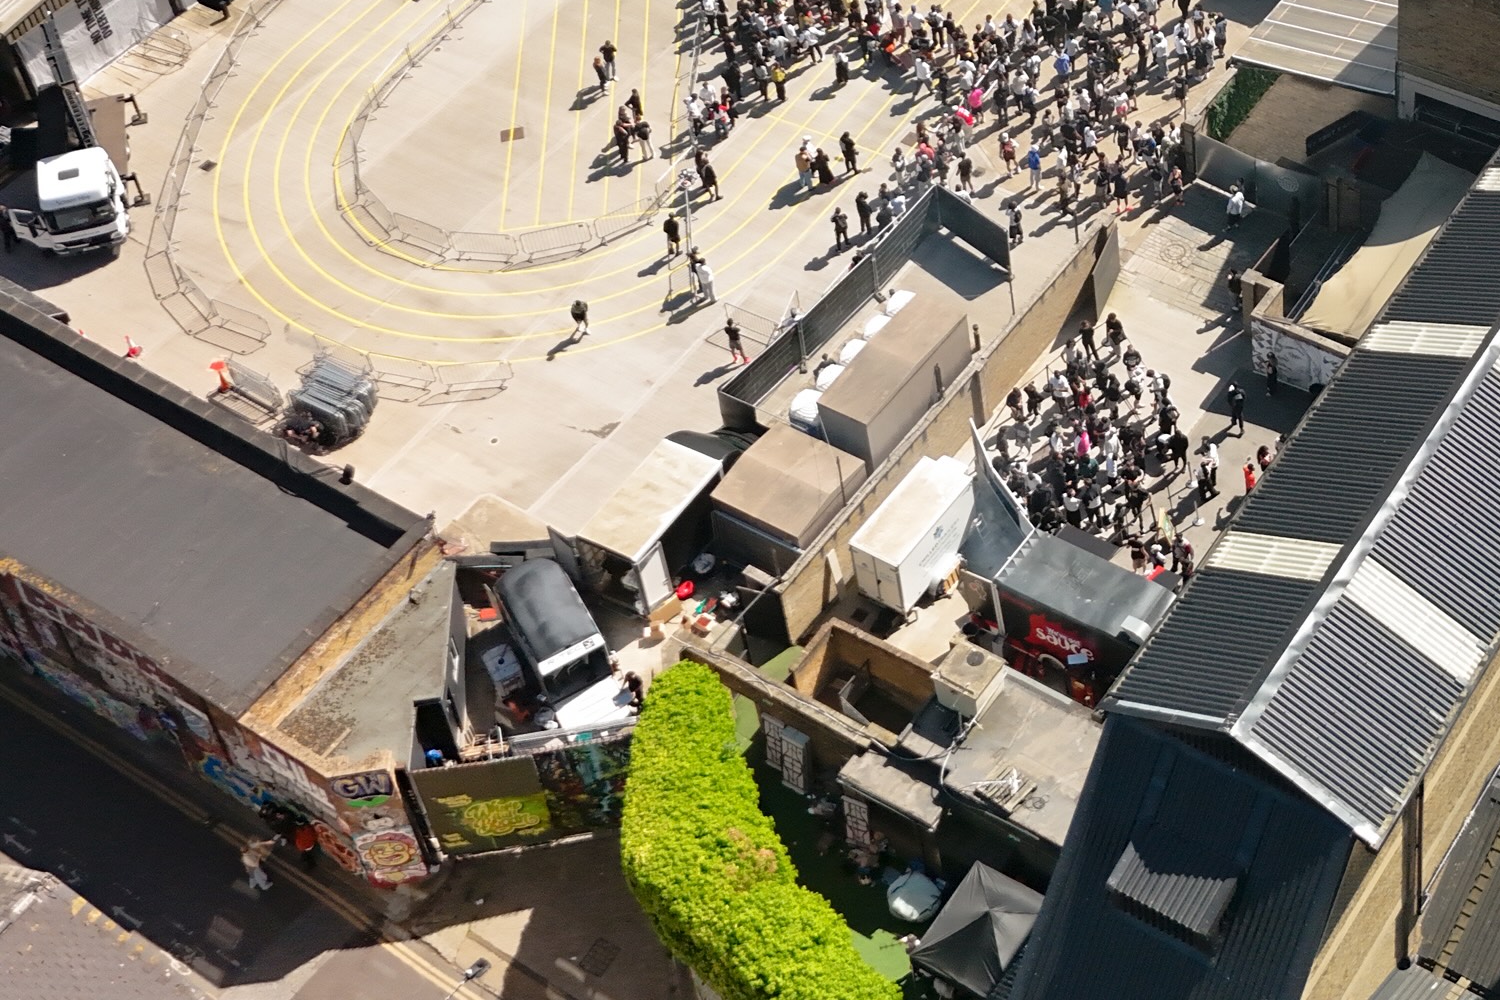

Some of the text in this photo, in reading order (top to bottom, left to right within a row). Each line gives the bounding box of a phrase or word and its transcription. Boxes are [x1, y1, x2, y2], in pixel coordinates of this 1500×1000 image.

[80, 7, 97, 31] TIME
[90, 29, 104, 45] NO
[332, 772, 394, 798] GW
